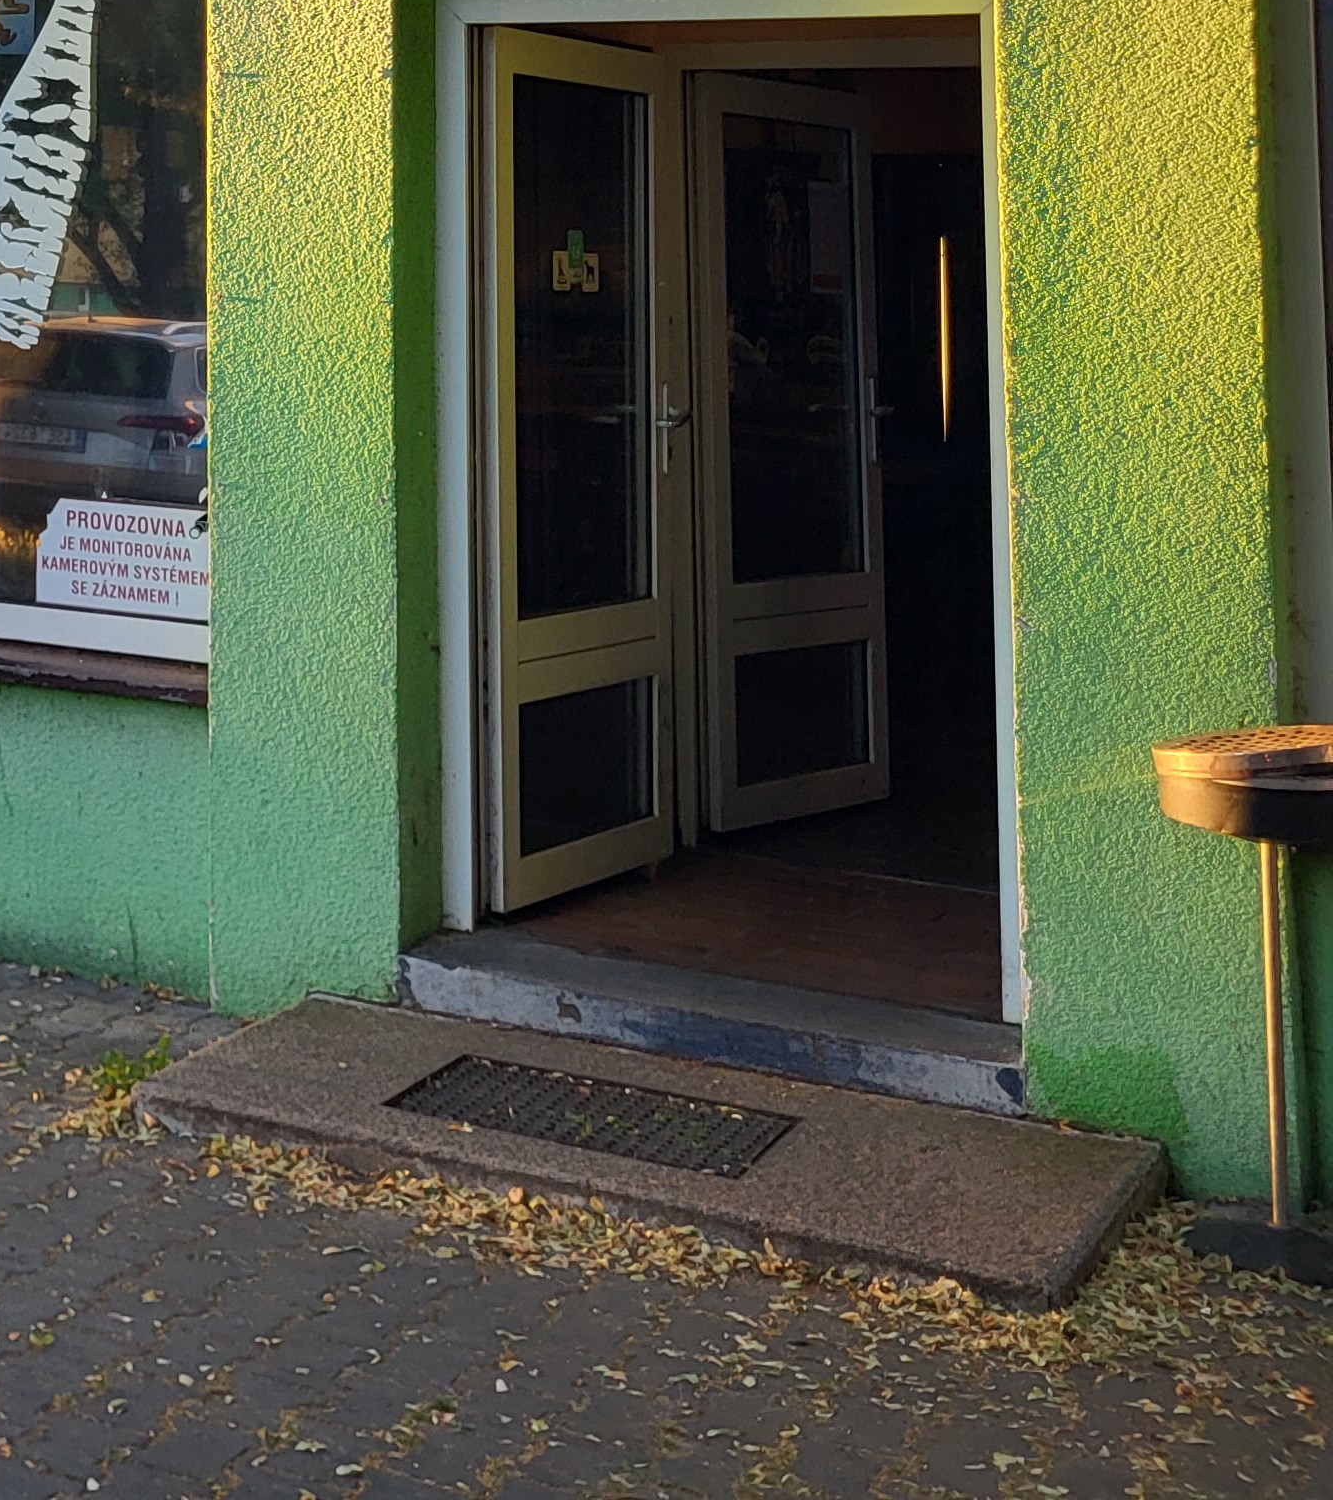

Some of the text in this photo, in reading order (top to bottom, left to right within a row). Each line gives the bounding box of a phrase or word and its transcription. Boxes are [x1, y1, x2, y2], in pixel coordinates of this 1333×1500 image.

[66, 509, 186, 538] PROVOZOVNA
[60, 535, 191, 562] JE MONITOROVÁNA
[41, 555, 210, 587] KAMEROVÝM SYSTÉMEM
[71, 580, 88, 596] SE
[92, 580, 170, 605] ZÁZNAMEM
